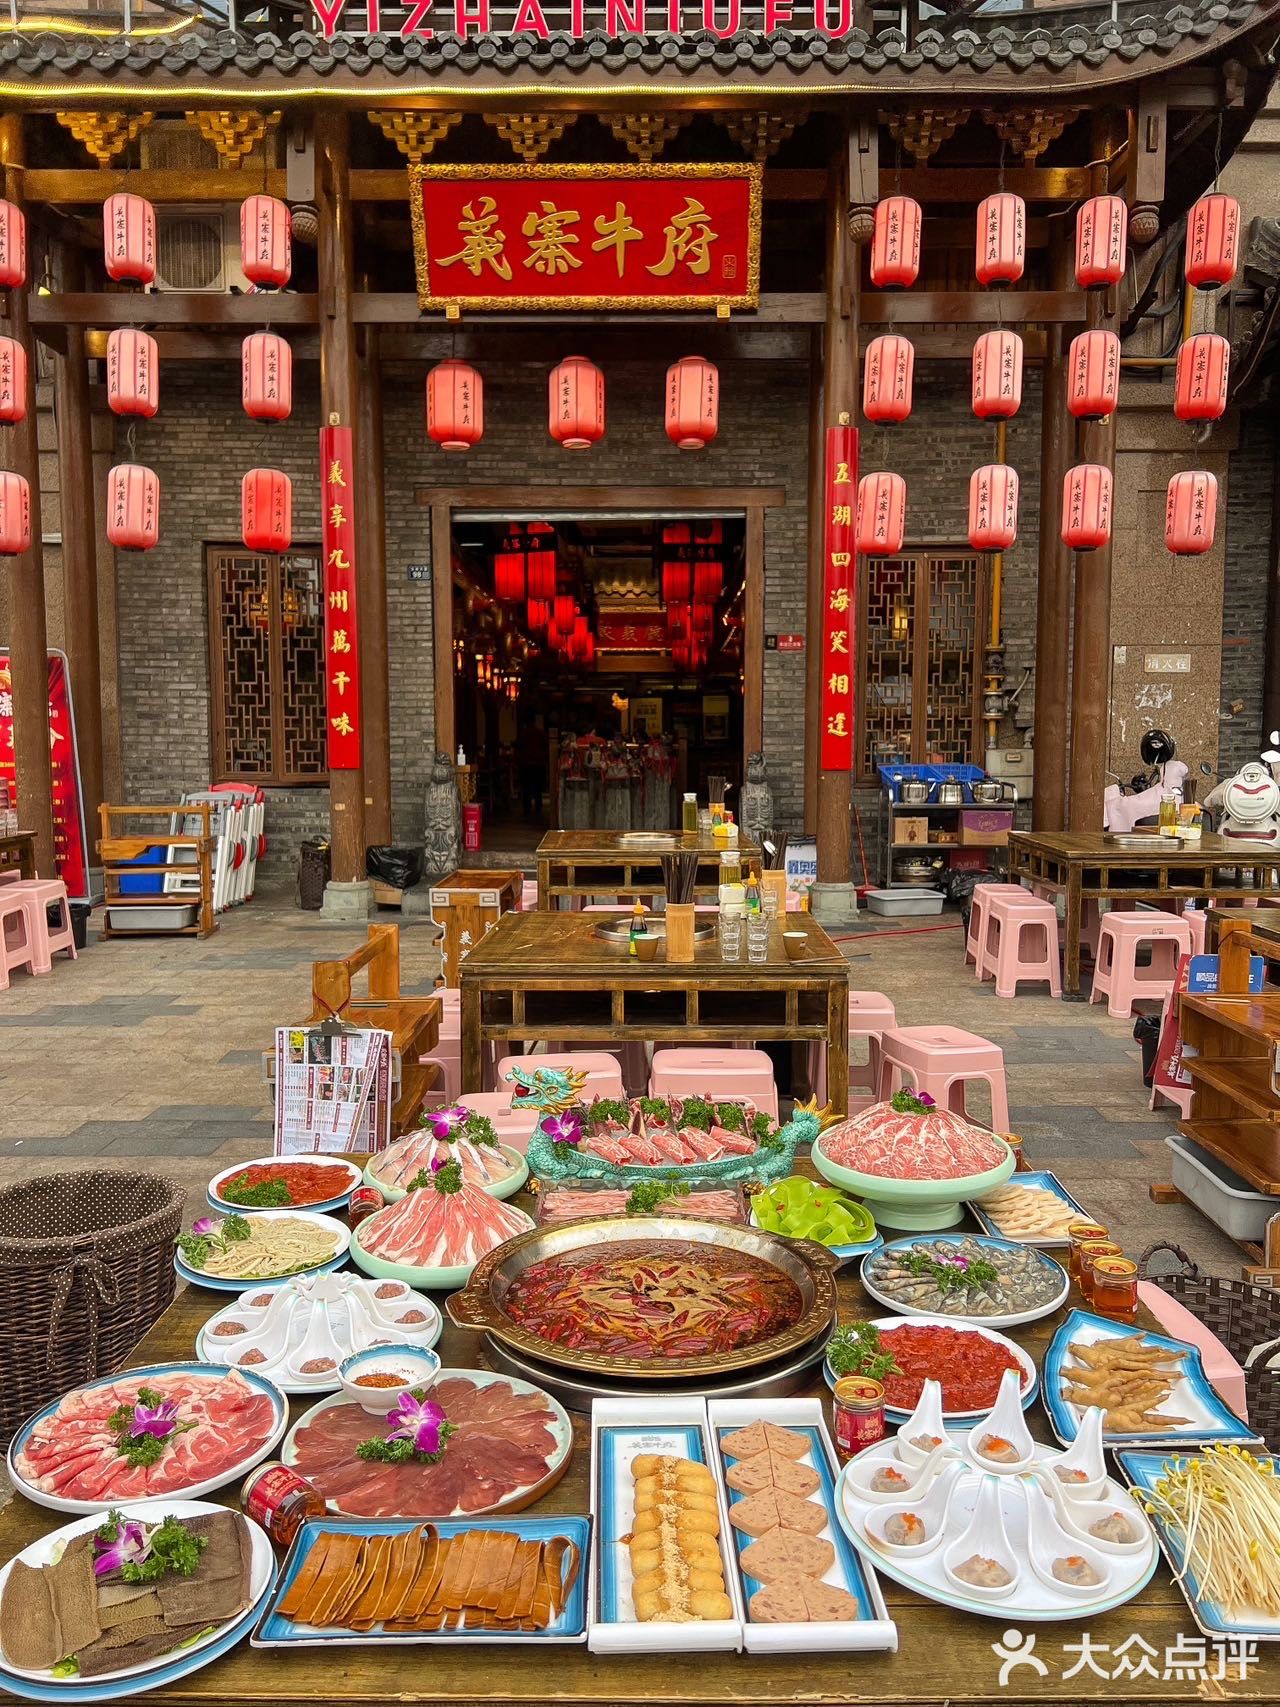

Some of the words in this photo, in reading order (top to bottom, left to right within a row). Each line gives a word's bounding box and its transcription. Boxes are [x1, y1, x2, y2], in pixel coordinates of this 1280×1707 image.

[313, 0, 854, 39] YIZHAINIUFU
[434, 196, 719, 281] 義寨牛府
[827, 462, 852, 736] 五湖四海笑相逢
